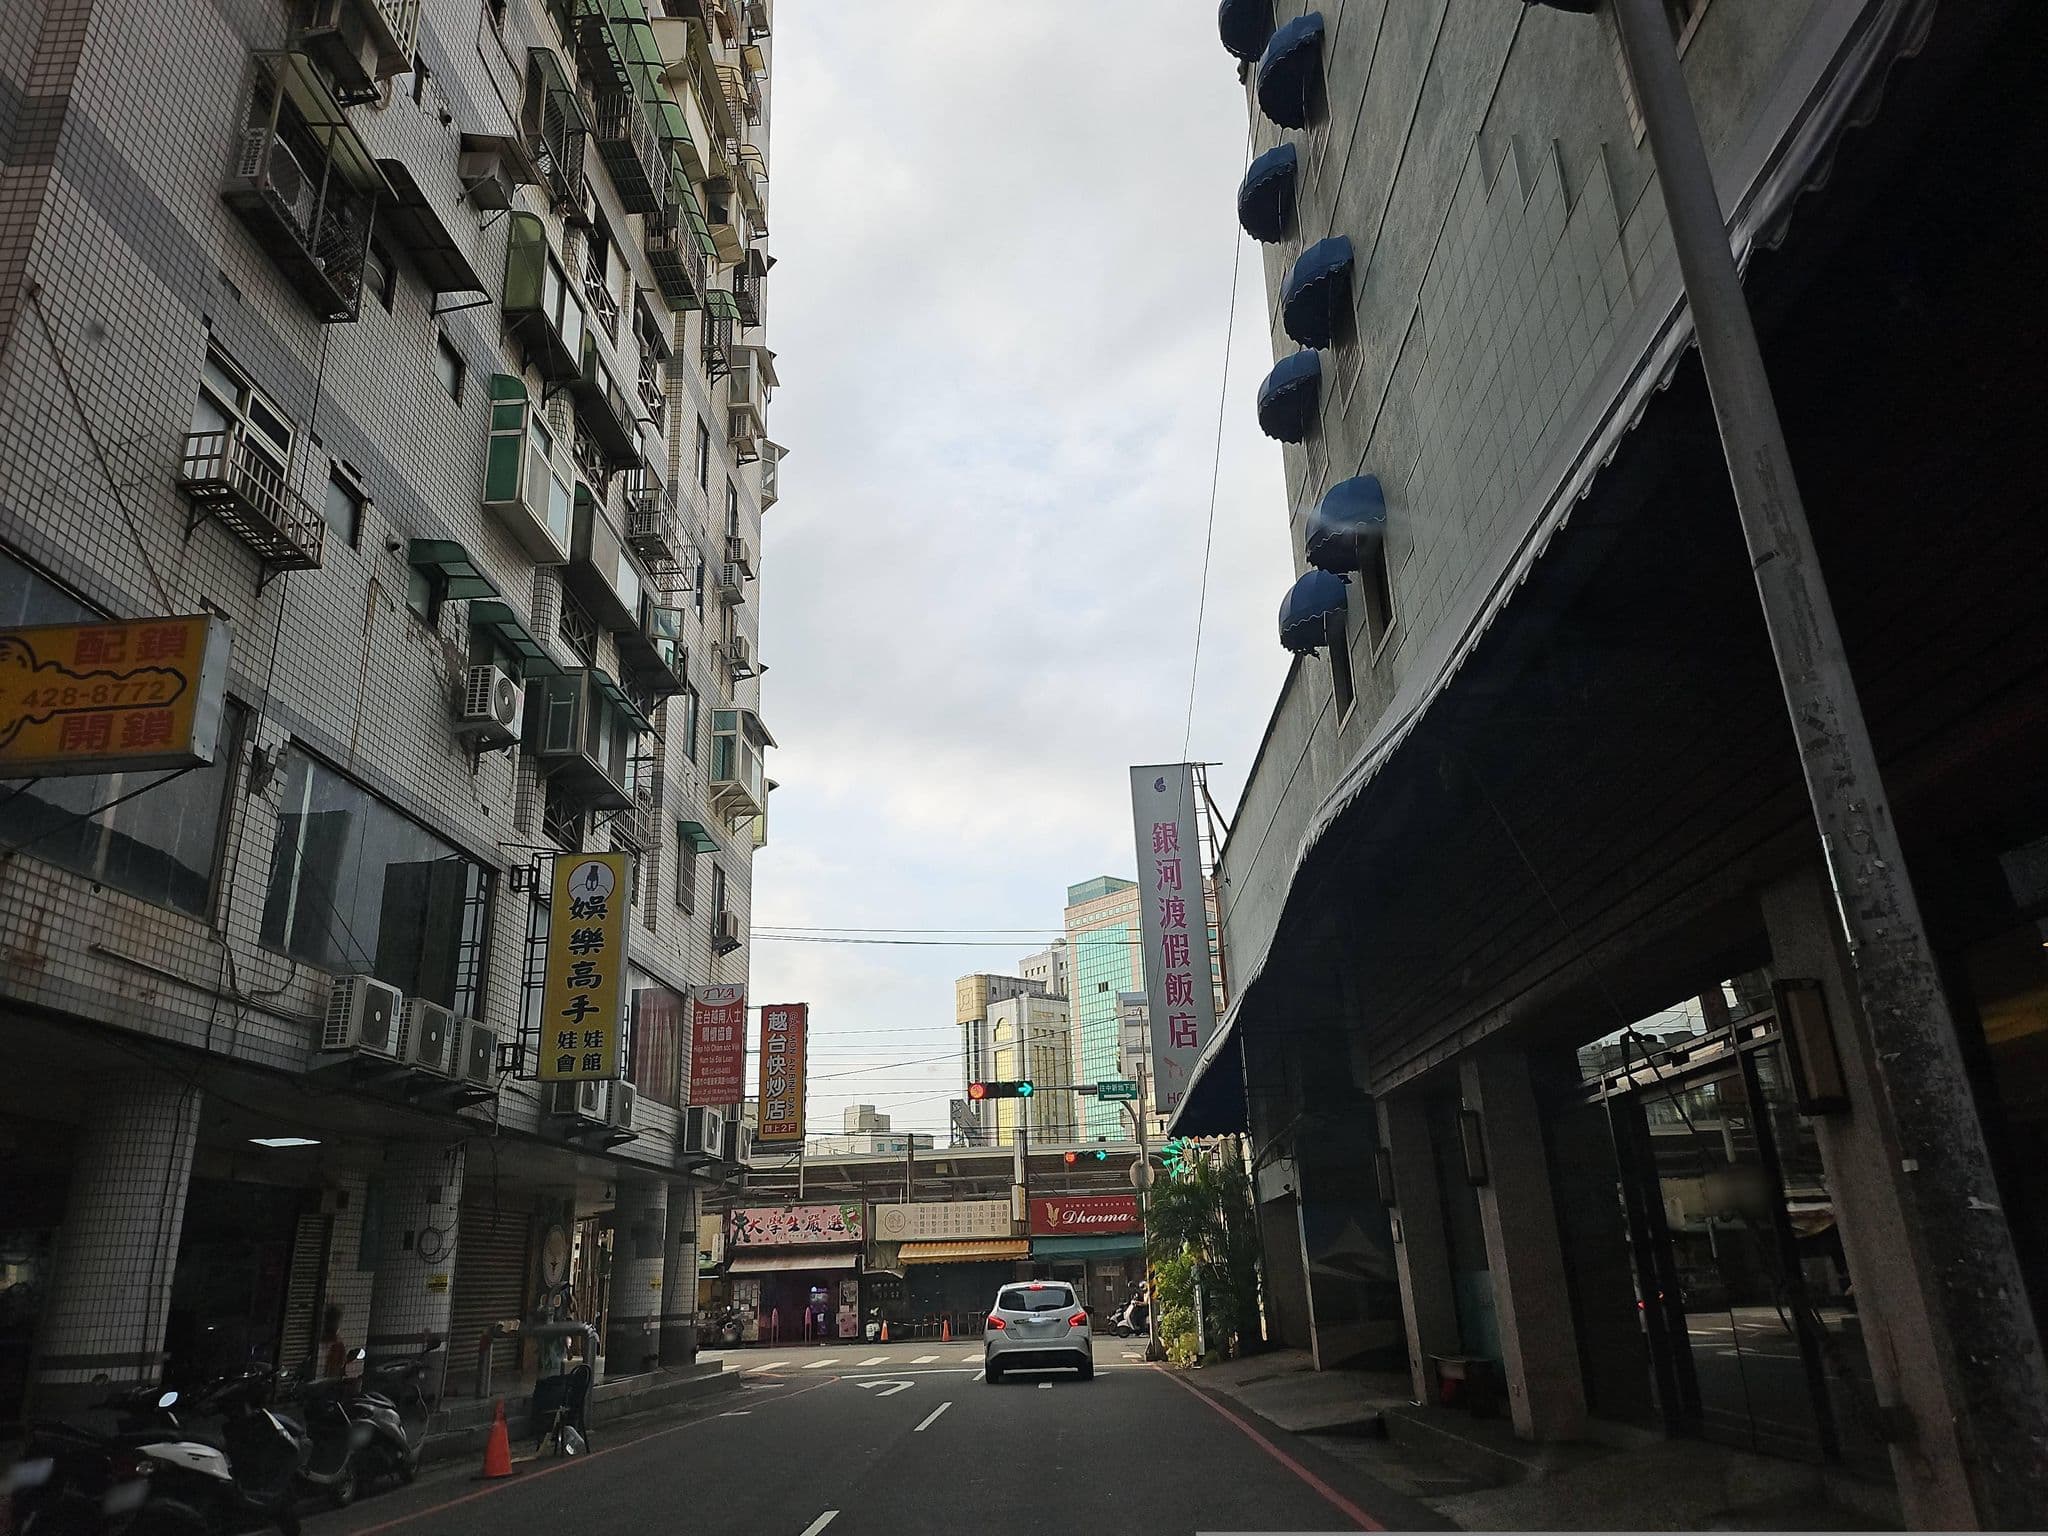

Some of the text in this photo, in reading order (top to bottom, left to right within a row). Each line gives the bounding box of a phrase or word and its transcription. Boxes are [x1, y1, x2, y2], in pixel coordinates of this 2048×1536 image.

[75, 625, 188, 665] 配鎖
[23, 681, 166, 709] 428-8772
[59, 712, 174, 752] 開鎖
[1152, 821, 1198, 1049] 銀河渡假飯店
[561, 896, 608, 1024] 娛樂高手
[695, 1008, 742, 1025] 在台越南人士
[765, 1011, 788, 1120] 越台快炒店
[1062, 1210, 1131, 1224] Dharma
